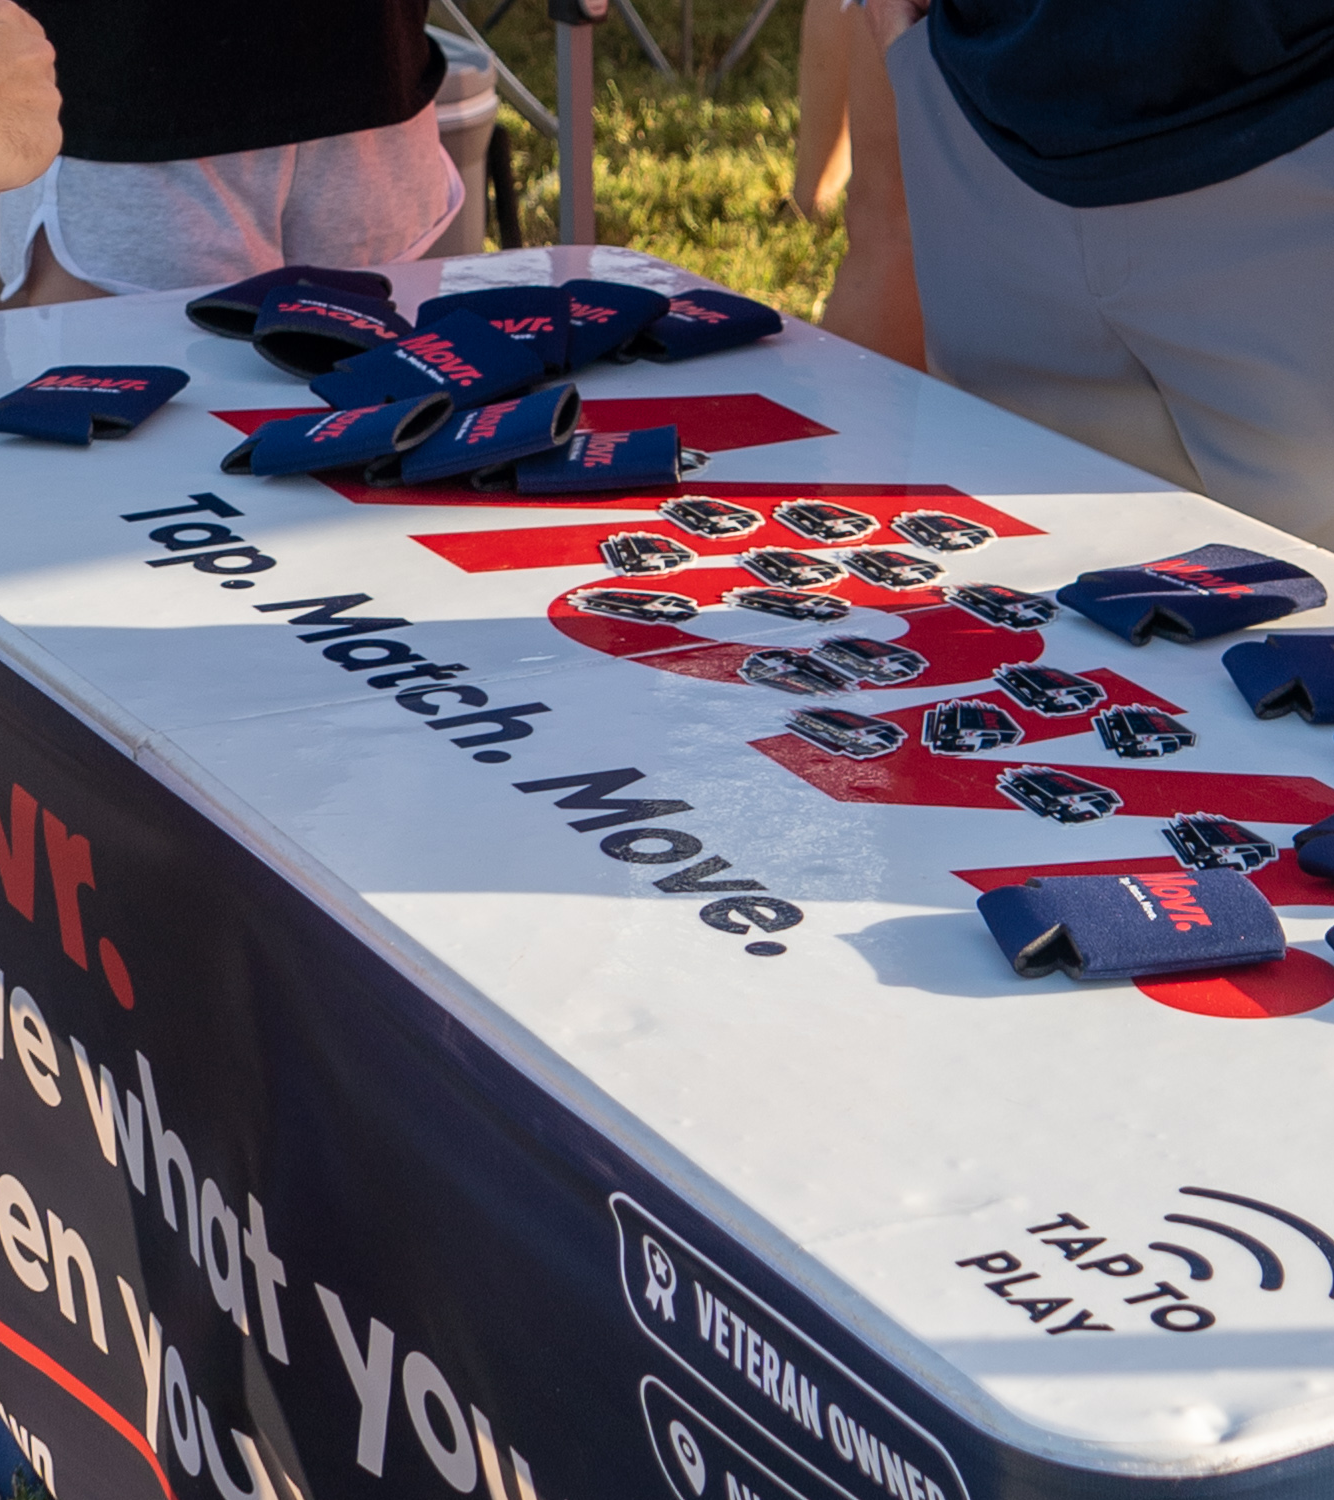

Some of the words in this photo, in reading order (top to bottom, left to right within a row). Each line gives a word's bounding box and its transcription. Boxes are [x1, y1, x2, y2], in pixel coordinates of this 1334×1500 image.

[27, 375, 149, 391] Movr.
[397, 333, 483, 387] Movr.
[584, 432, 631, 468] Movr.
[1140, 557, 1255, 600] Movr.
[119, 492, 277, 590] Tap.
[253, 592, 552, 764] Match.
[512, 766, 804, 957] Move.
[1131, 872, 1213, 932] Movr.
[70, 1034, 289, 1366] what
[954, 1249, 1116, 1336] PLAY
[1025, 1211, 1144, 1278] TAP
[1123, 1280, 1217, 1333] TO
[693, 1279, 823, 1441] VETERAN
